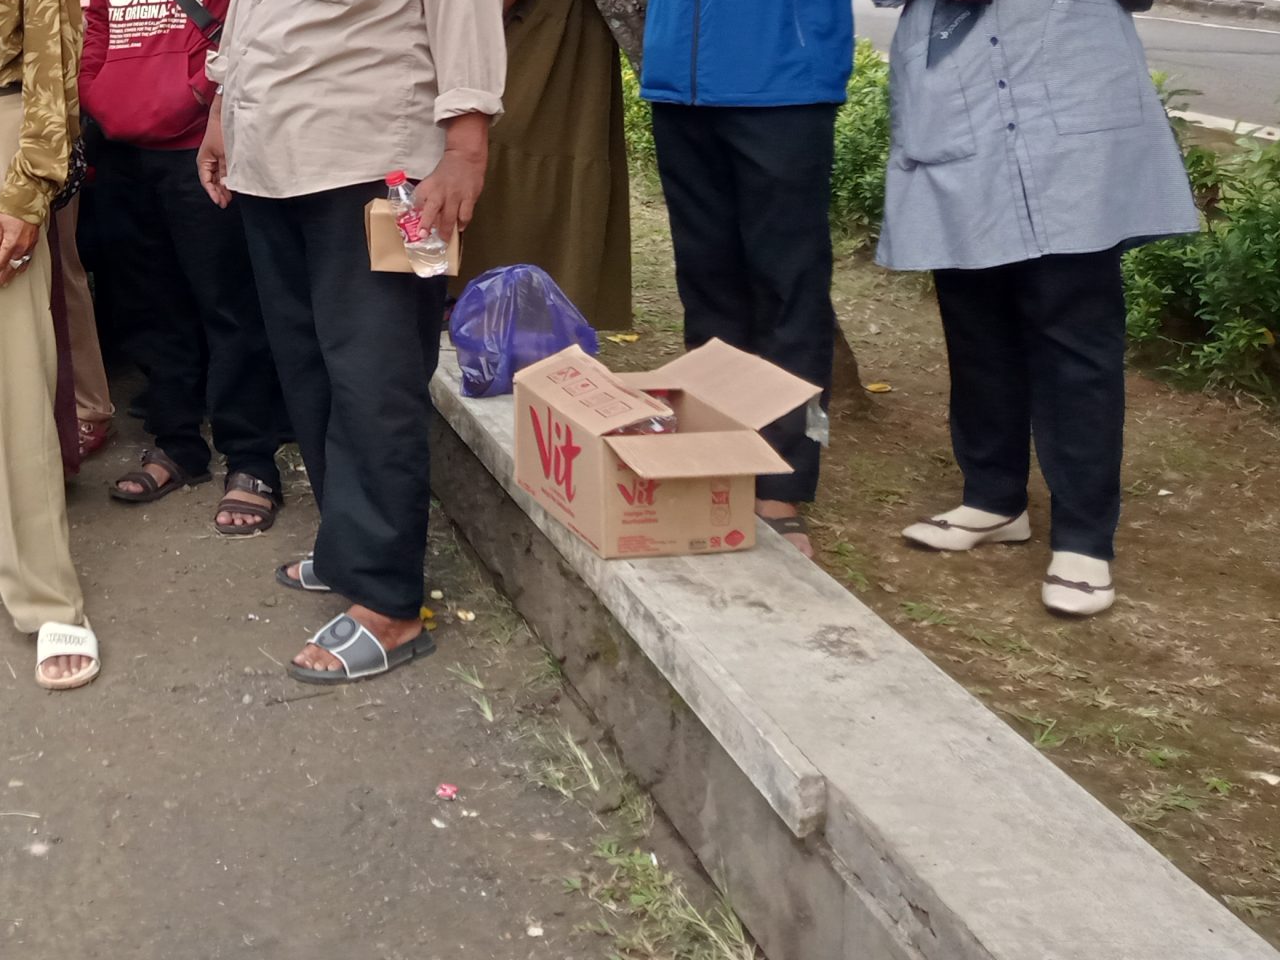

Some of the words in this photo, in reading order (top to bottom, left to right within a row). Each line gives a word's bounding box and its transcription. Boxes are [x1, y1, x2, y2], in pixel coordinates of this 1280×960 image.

[108, 8, 126, 21] THE
[529, 405, 582, 503] Vit
[616, 478, 661, 506] Vit
